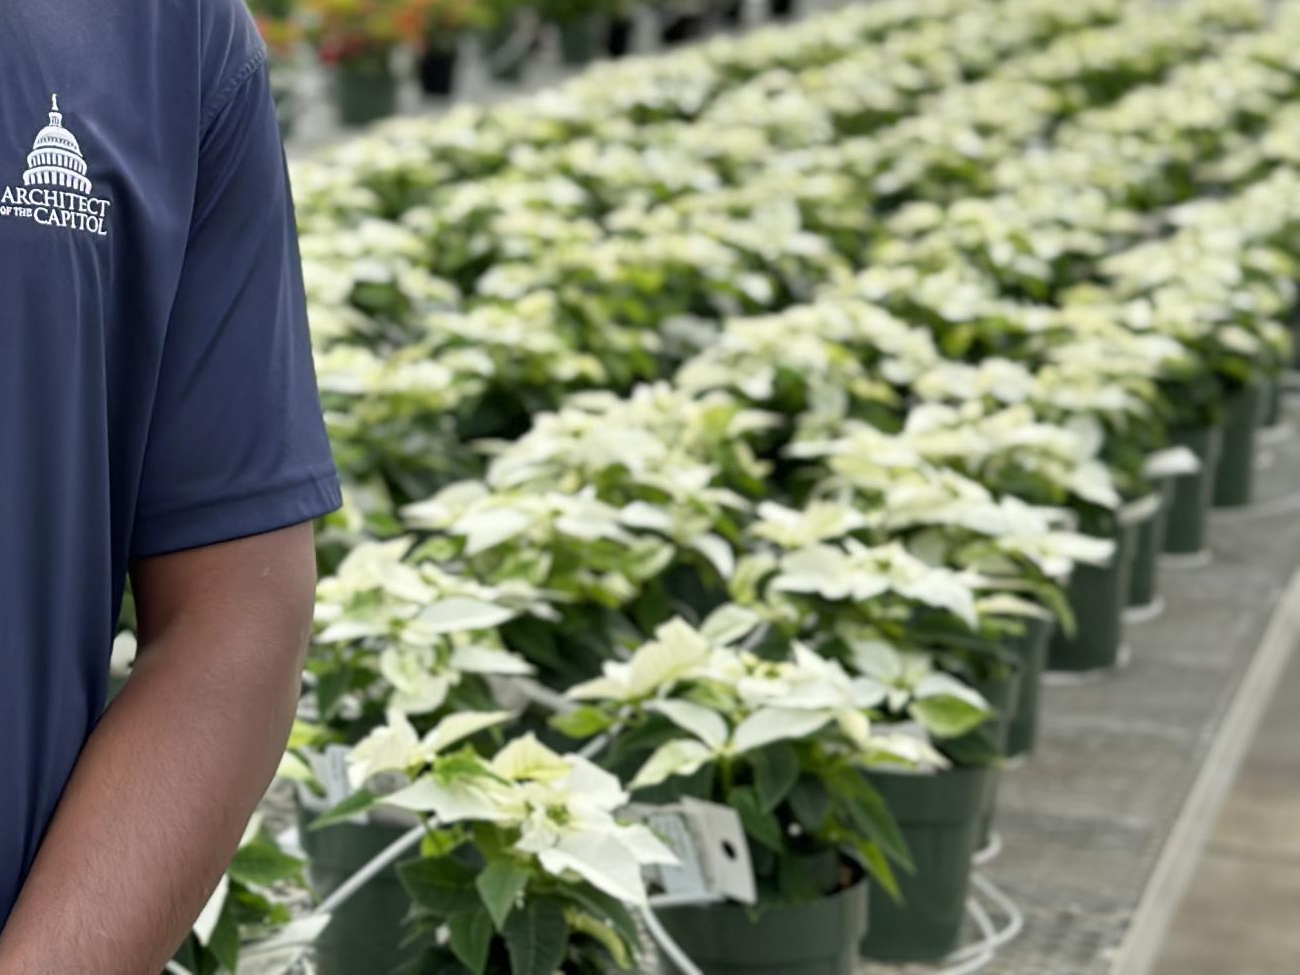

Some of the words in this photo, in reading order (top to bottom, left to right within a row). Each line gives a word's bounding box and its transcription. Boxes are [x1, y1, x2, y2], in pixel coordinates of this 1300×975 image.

[0, 185, 110, 217] ARCHITECT
[0, 205, 12, 216] OF
[13, 206, 33, 217] THE
[33, 207, 108, 236] CAPITOL
